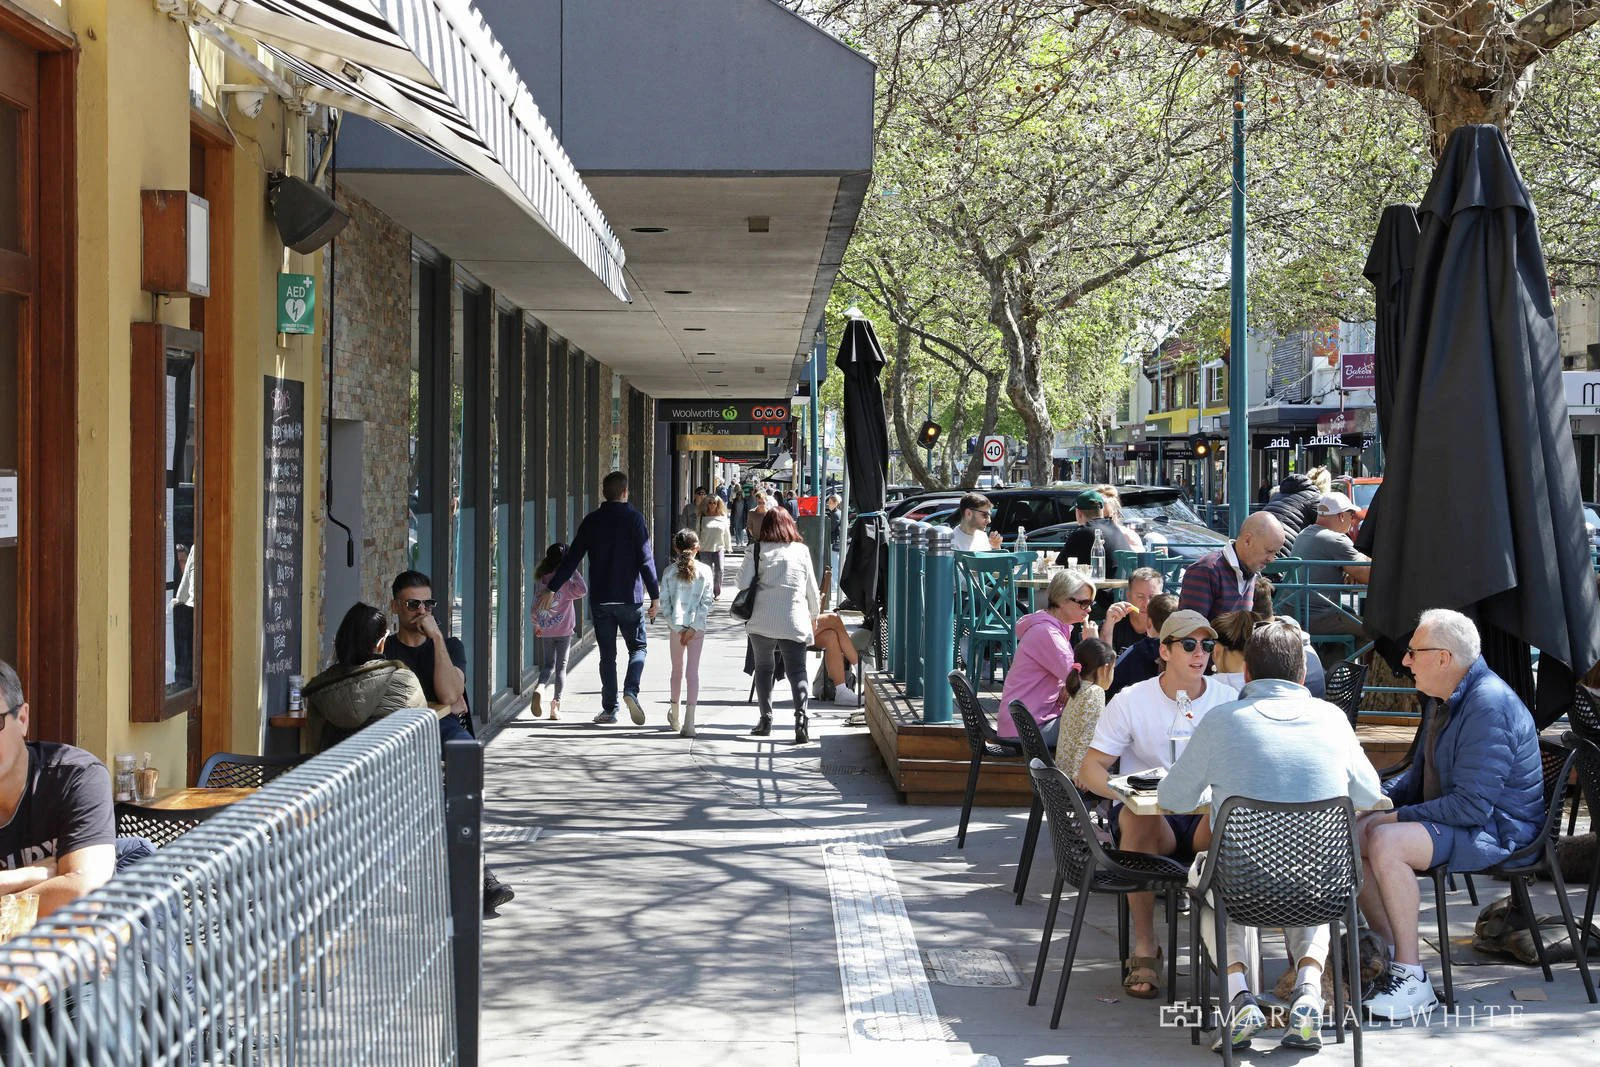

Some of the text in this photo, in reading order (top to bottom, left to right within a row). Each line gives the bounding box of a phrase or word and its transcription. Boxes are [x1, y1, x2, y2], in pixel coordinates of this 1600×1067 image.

[286, 286, 305, 298] AED
[672, 408, 720, 418] Woolworths
[754, 408, 785, 419] BWS
[1309, 433, 1342, 445] adairs
[987, 446, 1000, 456] 40
